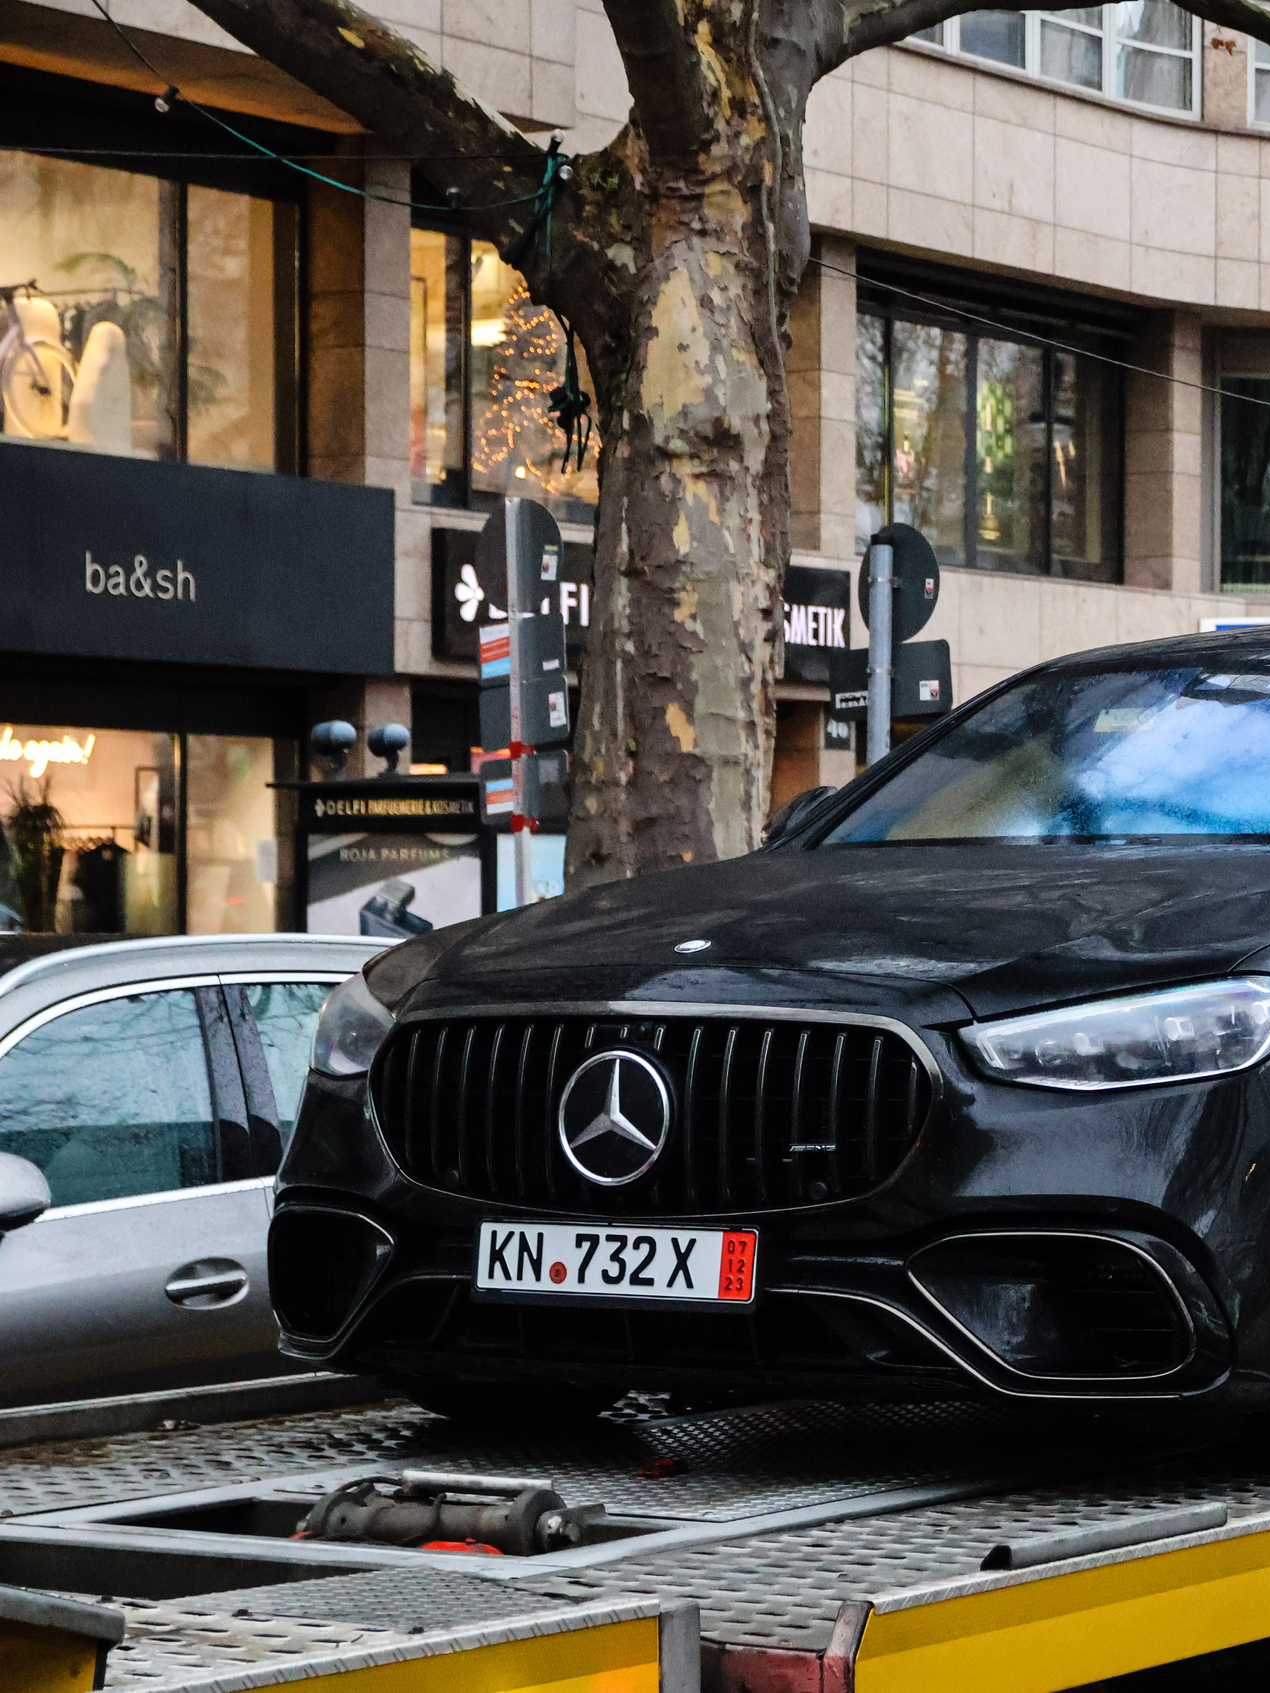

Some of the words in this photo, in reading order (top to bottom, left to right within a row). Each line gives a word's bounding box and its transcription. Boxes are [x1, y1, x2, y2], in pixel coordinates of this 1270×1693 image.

[86, 550, 196, 602] ba&sh
[325, 800, 366, 815] DELFI
[339, 848, 377, 862] ROJA
[381, 847, 450, 862] PARFUMS
[727, 1240, 747, 1254] 07
[488, 1230, 544, 1282] KN
[573, 1233, 657, 1286] 732
[666, 1237, 697, 1289] X
[728, 1258, 746, 1273] 12
[724, 1276, 744, 1291] 23
